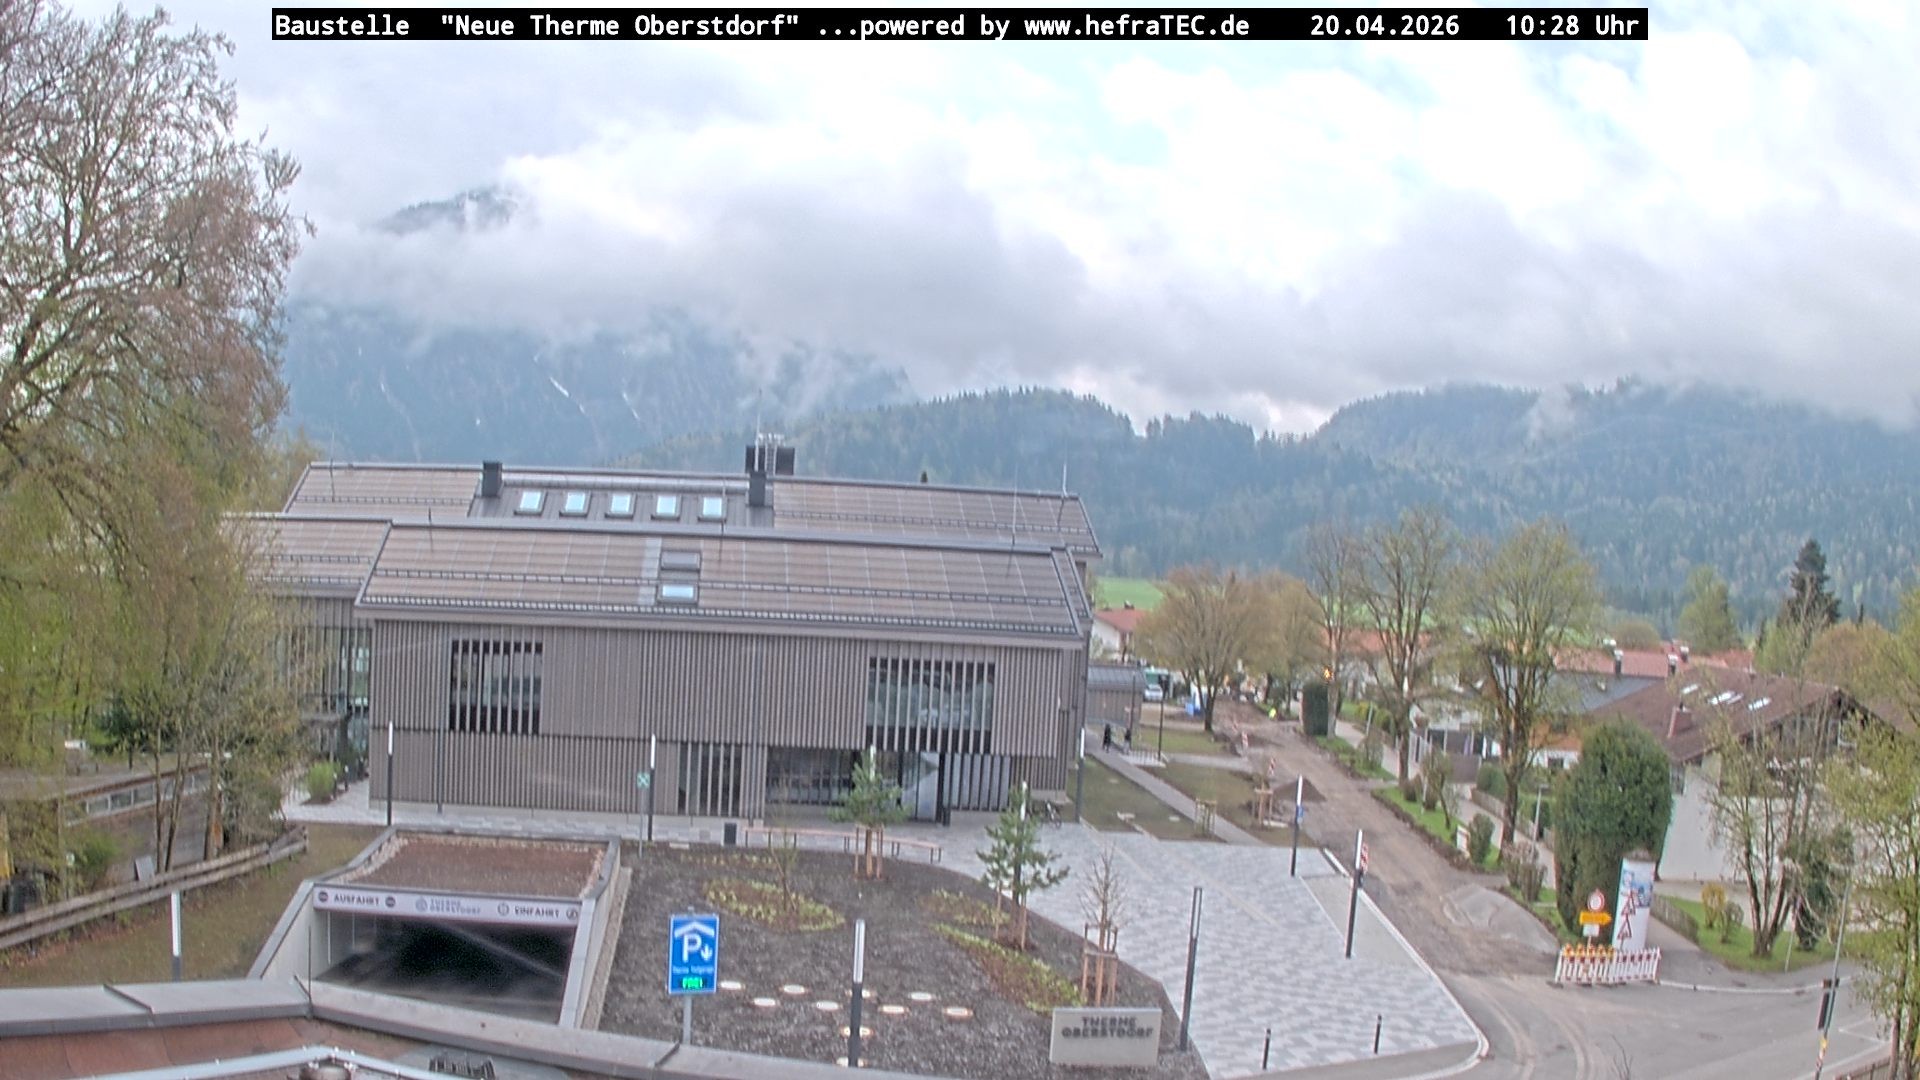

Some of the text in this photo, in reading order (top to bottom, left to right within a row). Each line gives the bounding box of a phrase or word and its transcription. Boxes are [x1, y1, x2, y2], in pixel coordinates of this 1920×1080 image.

[682, 933, 702, 962] P
[1082, 1016, 1136, 1027] THERME
[1061, 1027, 1154, 1038] OBERSTDORF
